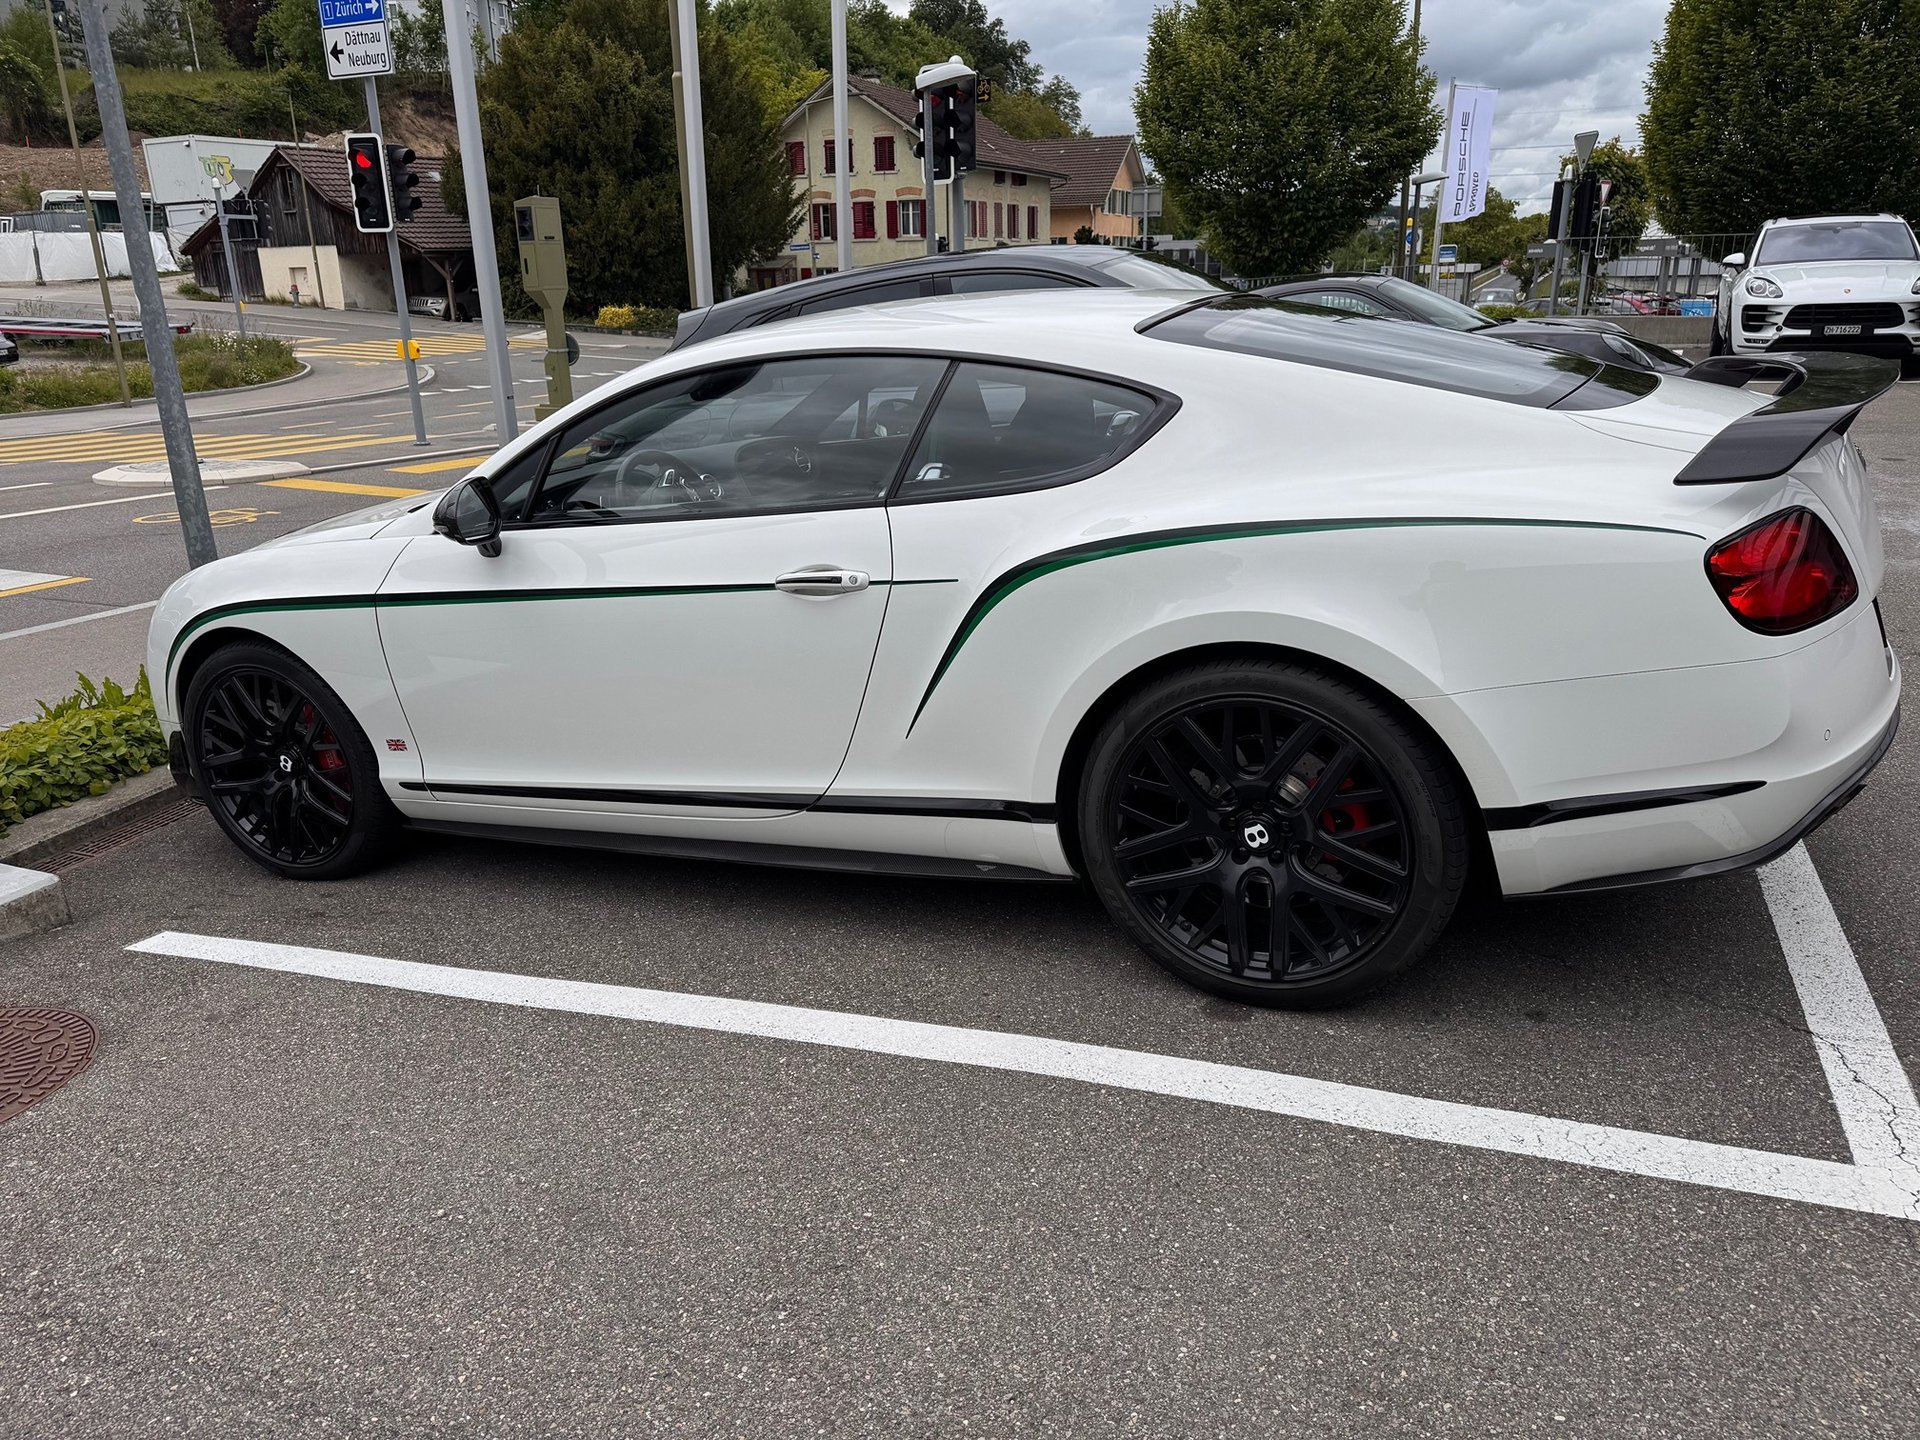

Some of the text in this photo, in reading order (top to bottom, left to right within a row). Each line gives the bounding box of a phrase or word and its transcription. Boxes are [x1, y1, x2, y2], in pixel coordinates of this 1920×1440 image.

[335, 0, 363, 17] Zürich
[344, 31, 381, 46] Dättnau
[348, 51, 386, 68] Neuburg
[1454, 112, 1470, 216] PORSCHE
